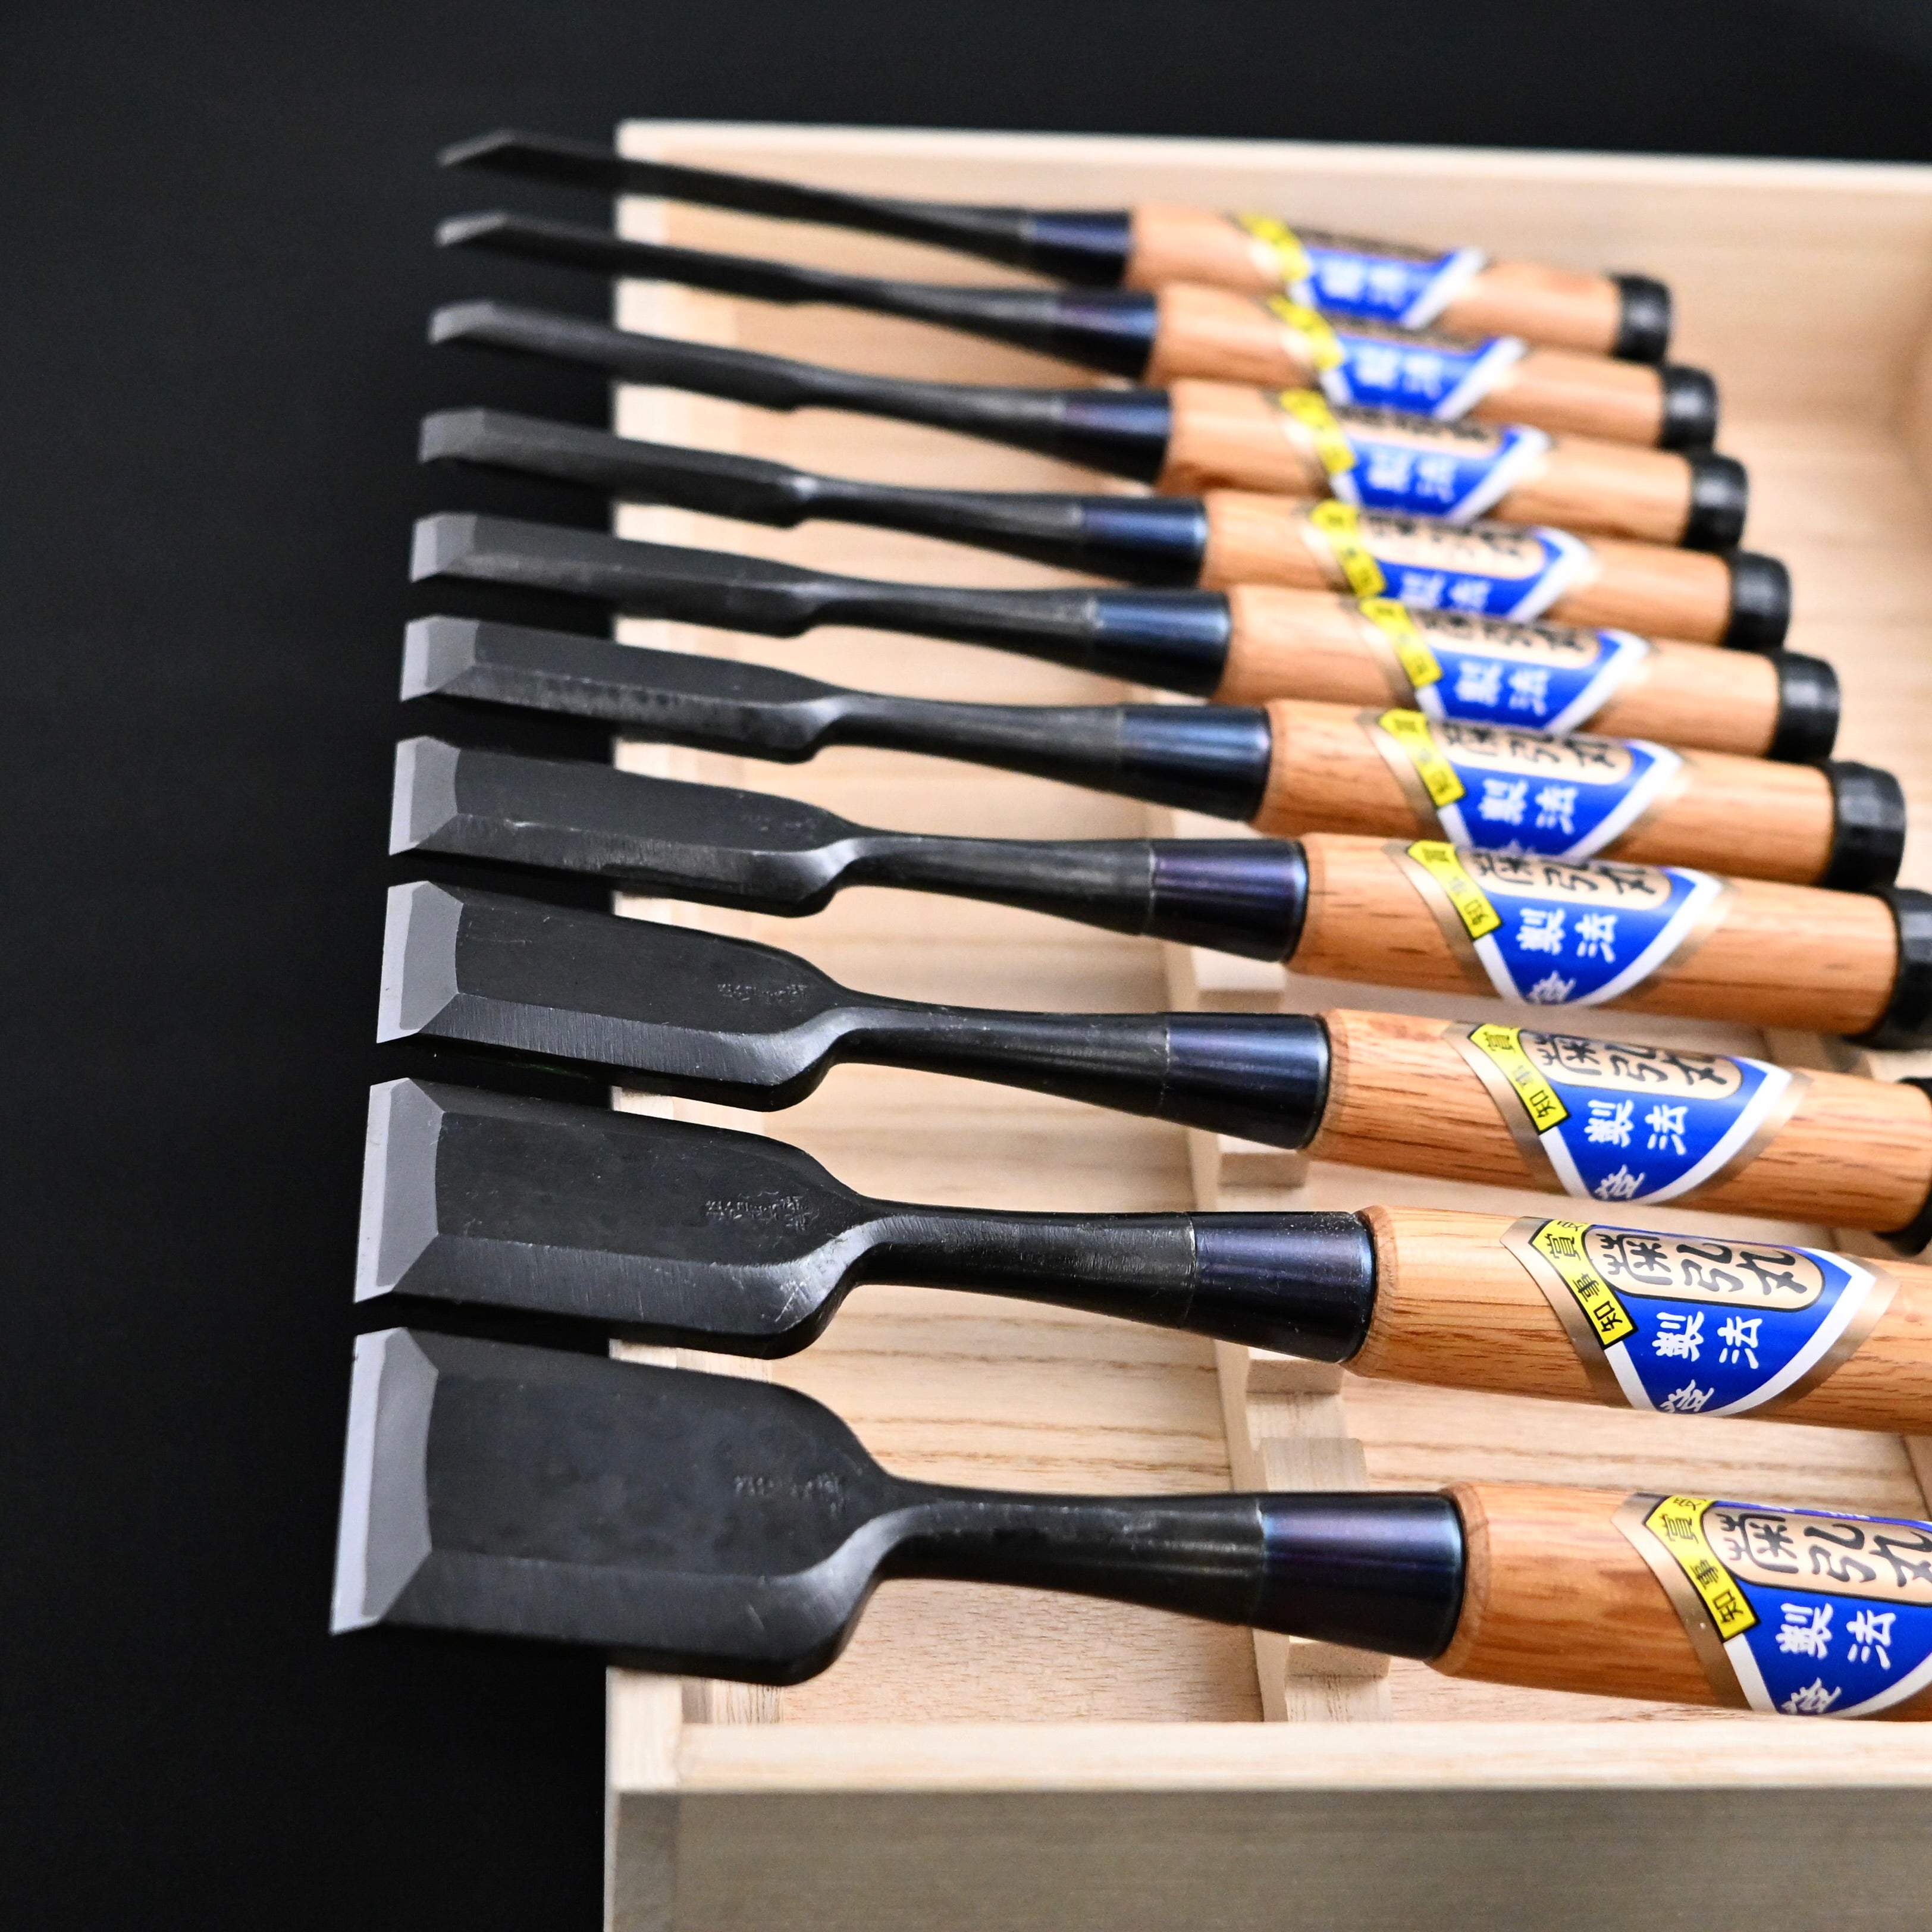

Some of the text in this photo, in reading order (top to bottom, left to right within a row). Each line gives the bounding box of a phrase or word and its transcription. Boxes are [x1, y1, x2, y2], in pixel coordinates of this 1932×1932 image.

[1515, 907, 1618, 963] 製法
[1533, 1033, 1729, 1086] 菊弘丸
[1583, 1099, 1689, 1156] 製法
[1595, 1232, 1809, 1296] 菊弘丸
[1651, 1310, 1764, 1370] 製法
[1714, 1511, 1932, 1589] 菊弘丸
[1775, 1602, 1897, 1671] 製法
